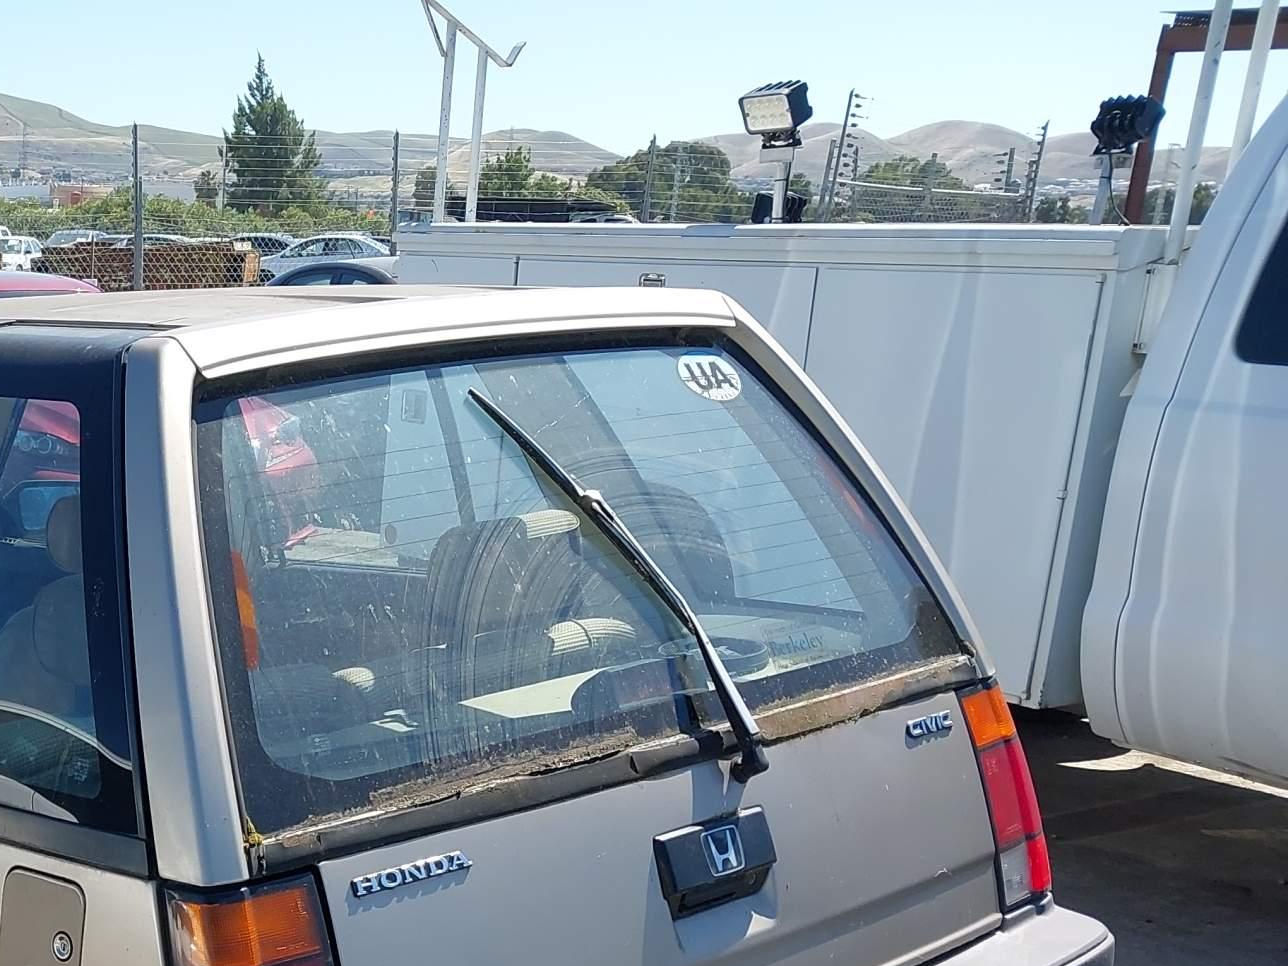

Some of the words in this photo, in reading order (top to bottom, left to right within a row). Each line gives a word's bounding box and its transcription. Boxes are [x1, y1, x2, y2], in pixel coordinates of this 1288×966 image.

[683, 361, 739, 391] UA
[768, 632, 824, 658] Berkeley
[907, 710, 953, 736] CIVIC
[352, 850, 473, 897] HONDA
